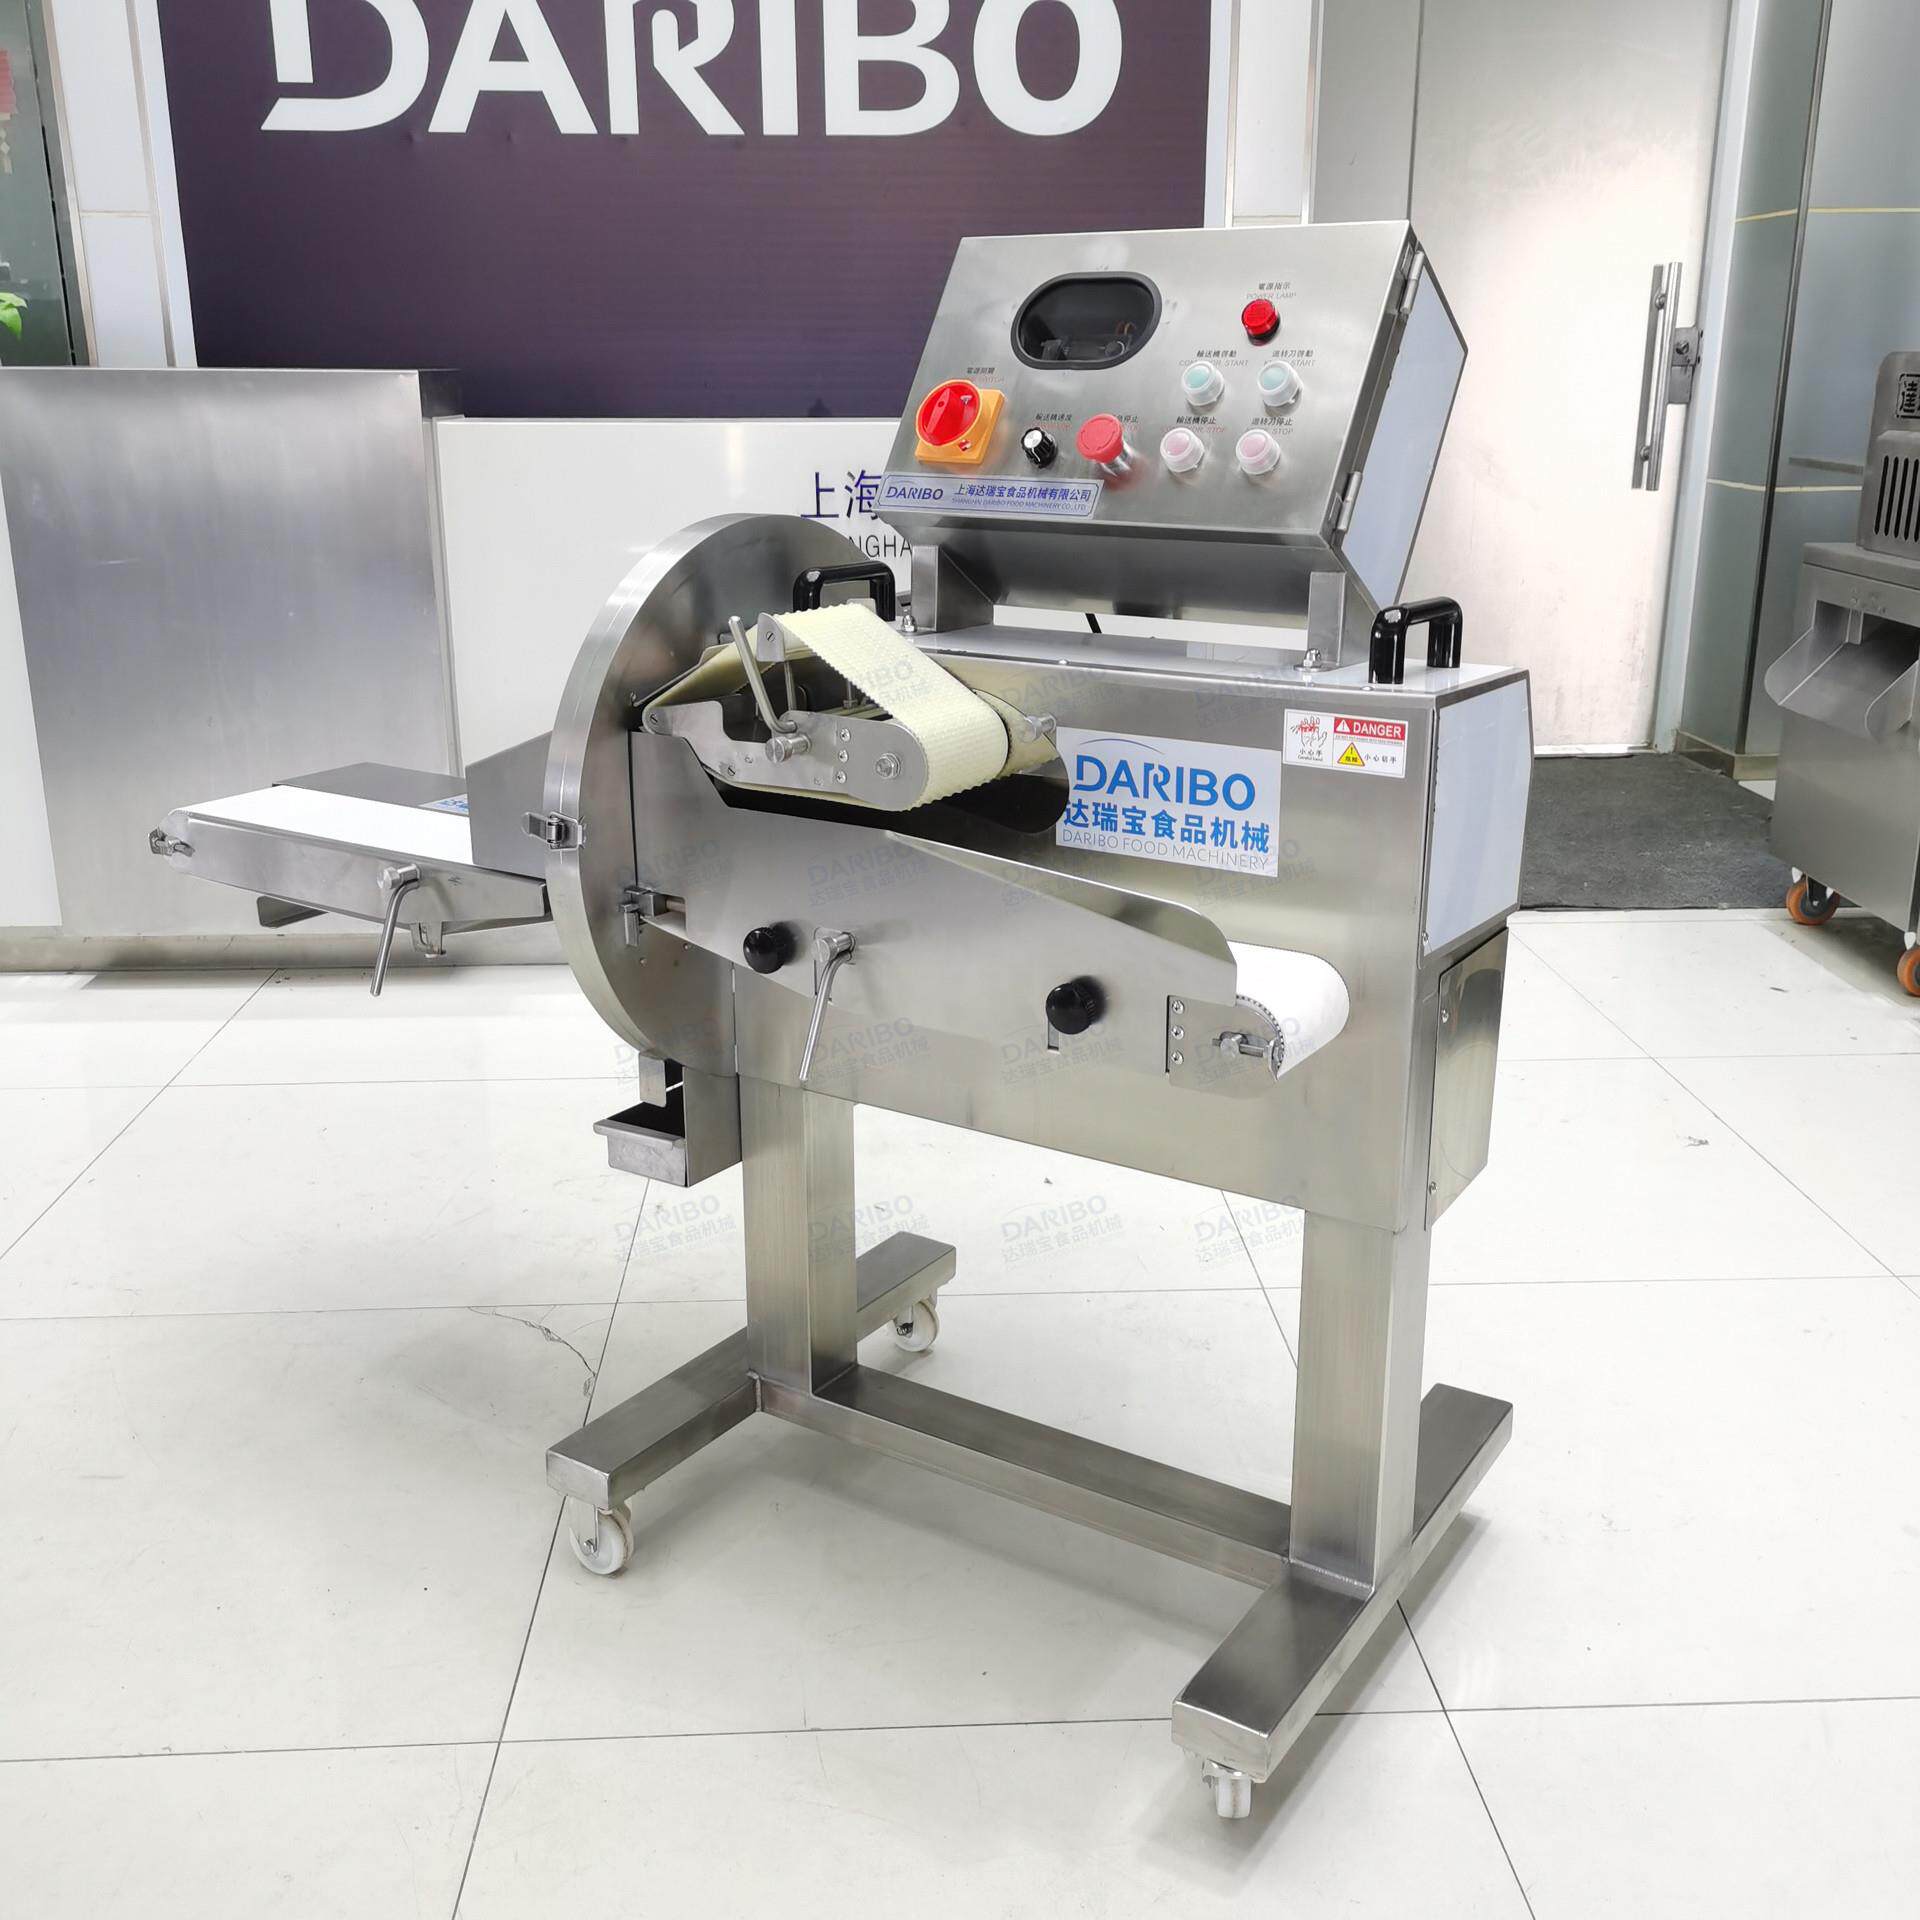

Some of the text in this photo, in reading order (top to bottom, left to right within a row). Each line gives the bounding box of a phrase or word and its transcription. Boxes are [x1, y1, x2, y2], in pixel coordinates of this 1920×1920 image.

[261, 0, 1122, 136] DARIBO
[800, 469, 882, 520] 上海
[885, 486, 944, 501] DARIBO
[954, 483, 1092, 502] 上海达瑞宝食品机械有限公司
[1352, 721, 1402, 738] DANGER
[1073, 754, 1256, 811] DARIBO
[1062, 828, 1269, 871] DARIBO FOOD MACHINERY
[1063, 798, 1270, 854] 达瑞宝食品机械
